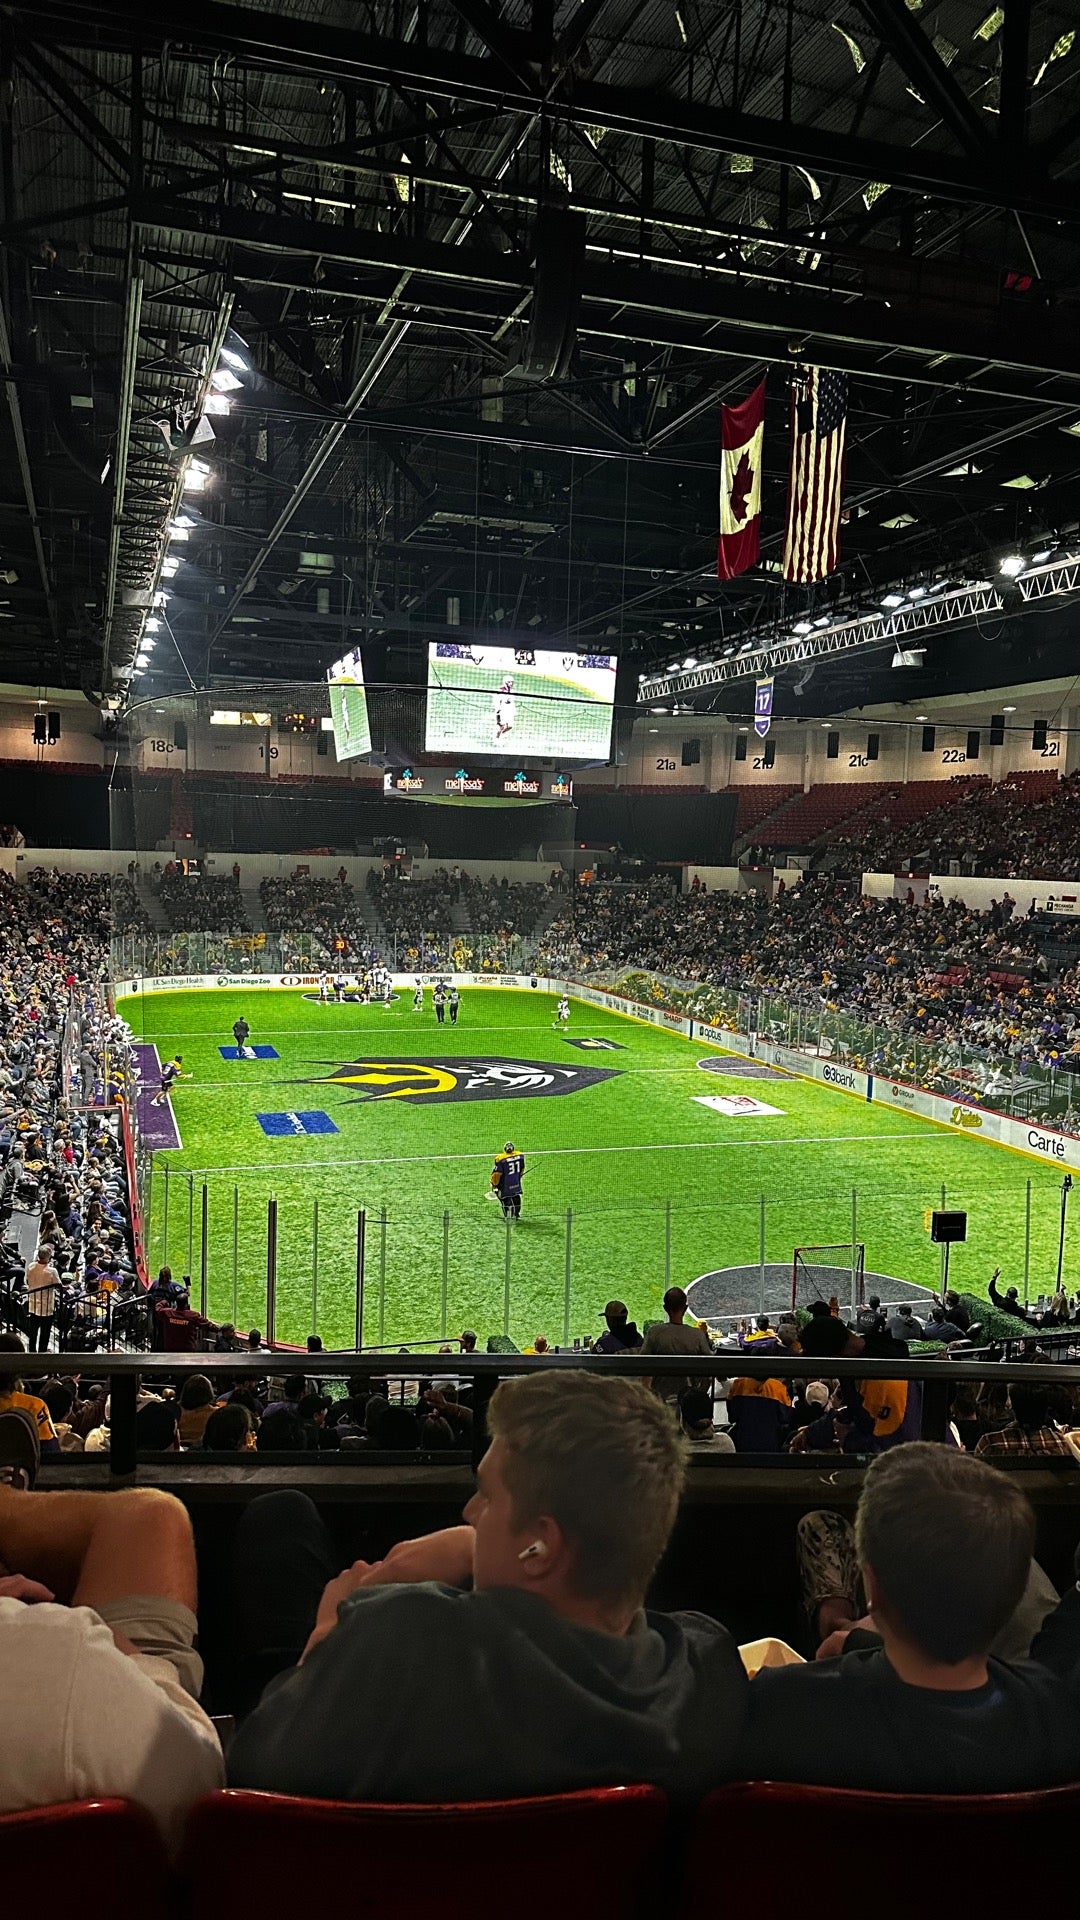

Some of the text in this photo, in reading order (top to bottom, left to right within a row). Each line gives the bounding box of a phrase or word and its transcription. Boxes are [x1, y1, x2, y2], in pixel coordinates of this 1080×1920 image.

[758, 692, 770, 711] 17
[150, 740, 175, 753] 18c
[848, 754, 869, 767] 21c
[941, 749, 966, 763] 22a
[656, 758, 676, 771] 21a
[663, 1012, 683, 1024] SHARP
[823, 1065, 856, 1089] C3bank
[1027, 1130, 1066, 1157] Carté
[508, 1160, 521, 1176] 31
